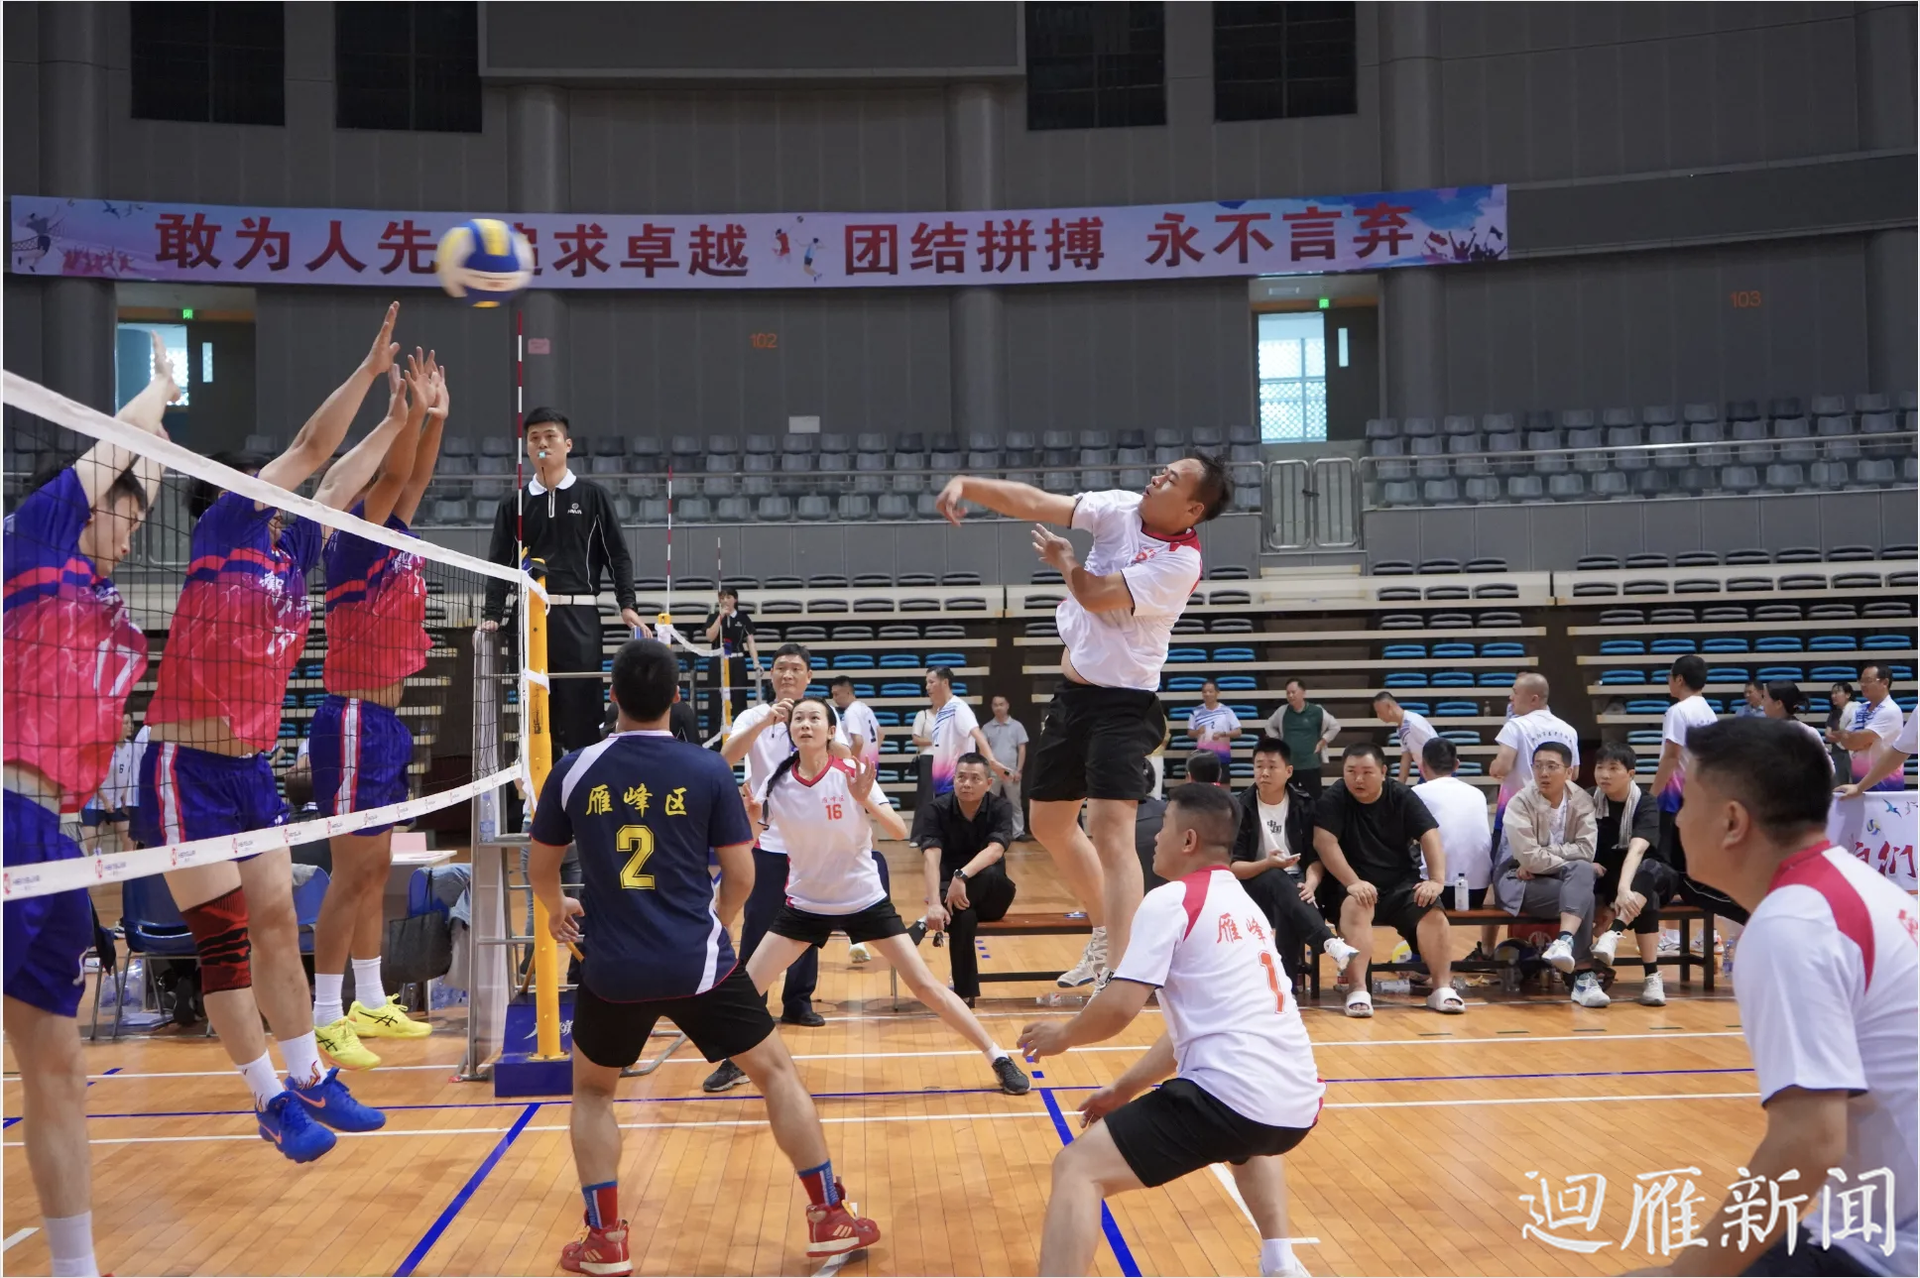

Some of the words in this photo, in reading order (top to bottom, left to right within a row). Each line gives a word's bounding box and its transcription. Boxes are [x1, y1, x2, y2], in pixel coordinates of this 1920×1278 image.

[155, 212, 438, 275] 敢为人先
[844, 217, 1105, 276] 团结拼搏
[1145, 203, 1413, 267] 永不言弃
[1730, 290, 1761, 309] 103
[749, 333, 778, 349] 102
[585, 783, 688, 818] 雁峰区
[825, 803, 844, 821] 16
[616, 824, 656, 890] 2
[1258, 949, 1288, 1015] 1
